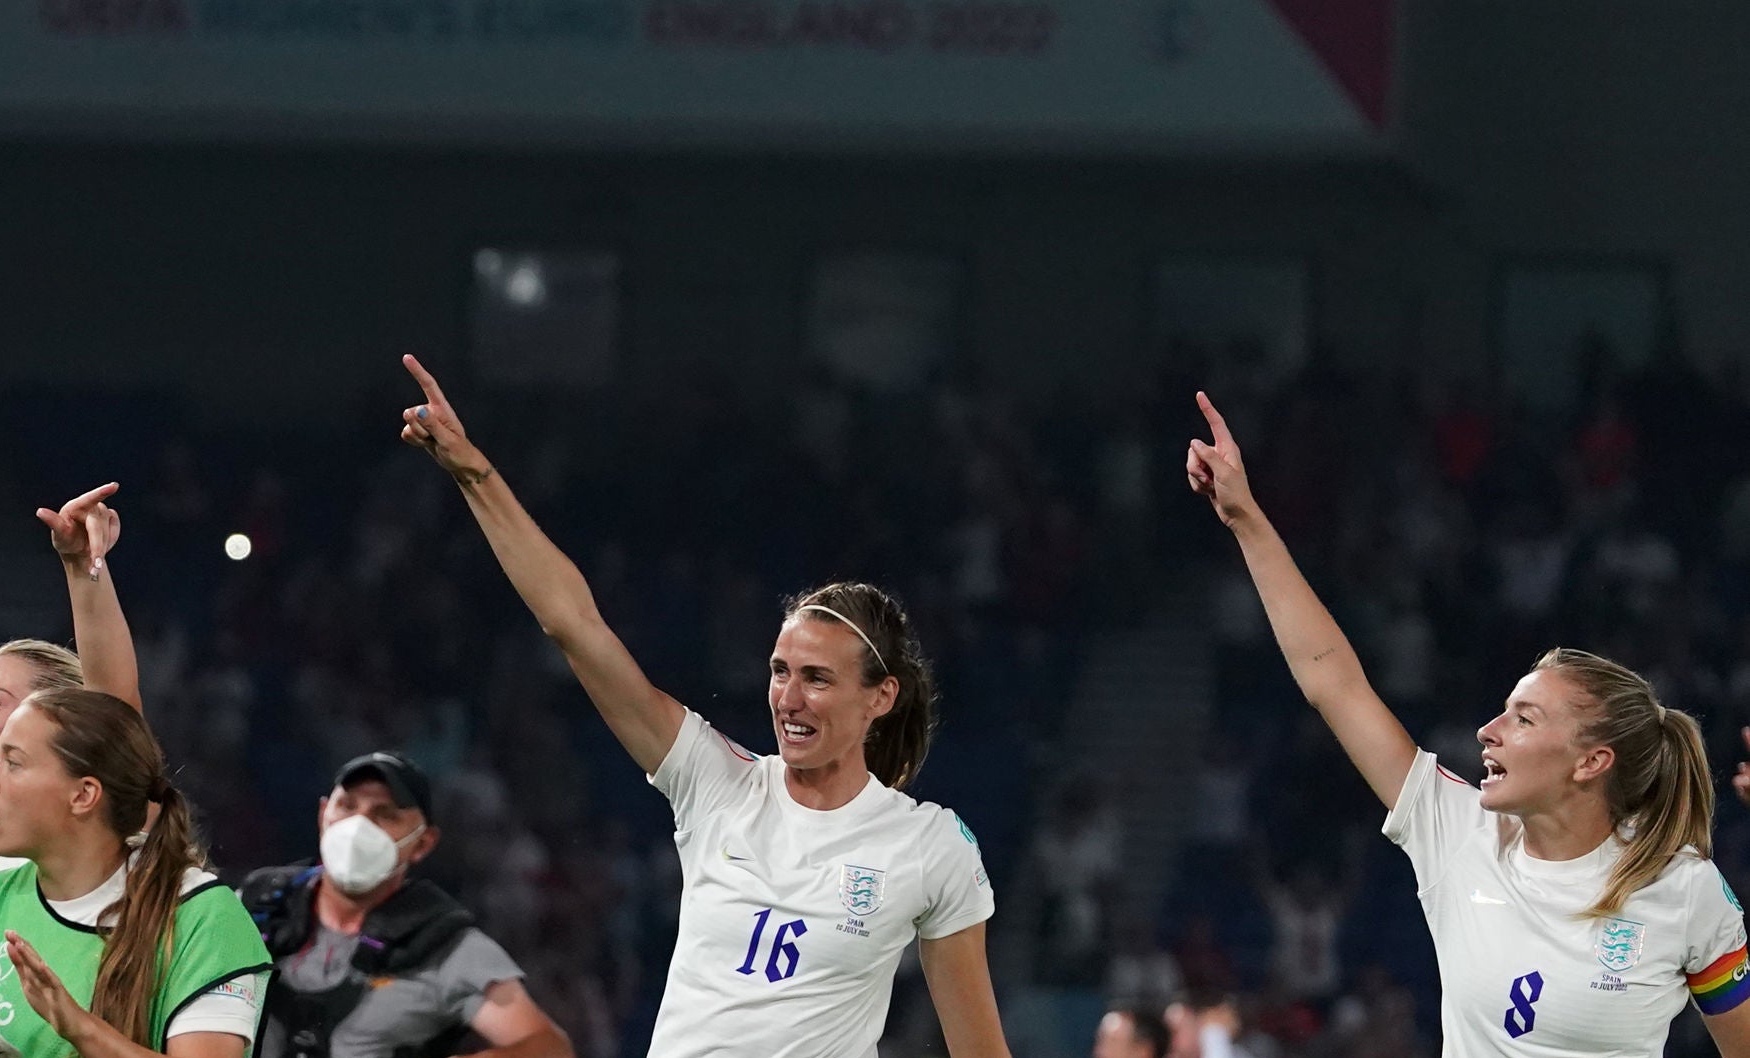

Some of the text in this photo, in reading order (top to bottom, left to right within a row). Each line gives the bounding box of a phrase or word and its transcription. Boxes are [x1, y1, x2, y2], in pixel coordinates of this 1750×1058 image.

[846, 917, 864, 928] SPAIN
[843, 925, 857, 935] JULY
[736, 908, 807, 983] 16
[1602, 974, 1621, 983] SPAIN
[1598, 982, 1614, 991] JULY
[1504, 971, 1544, 1039] 8
